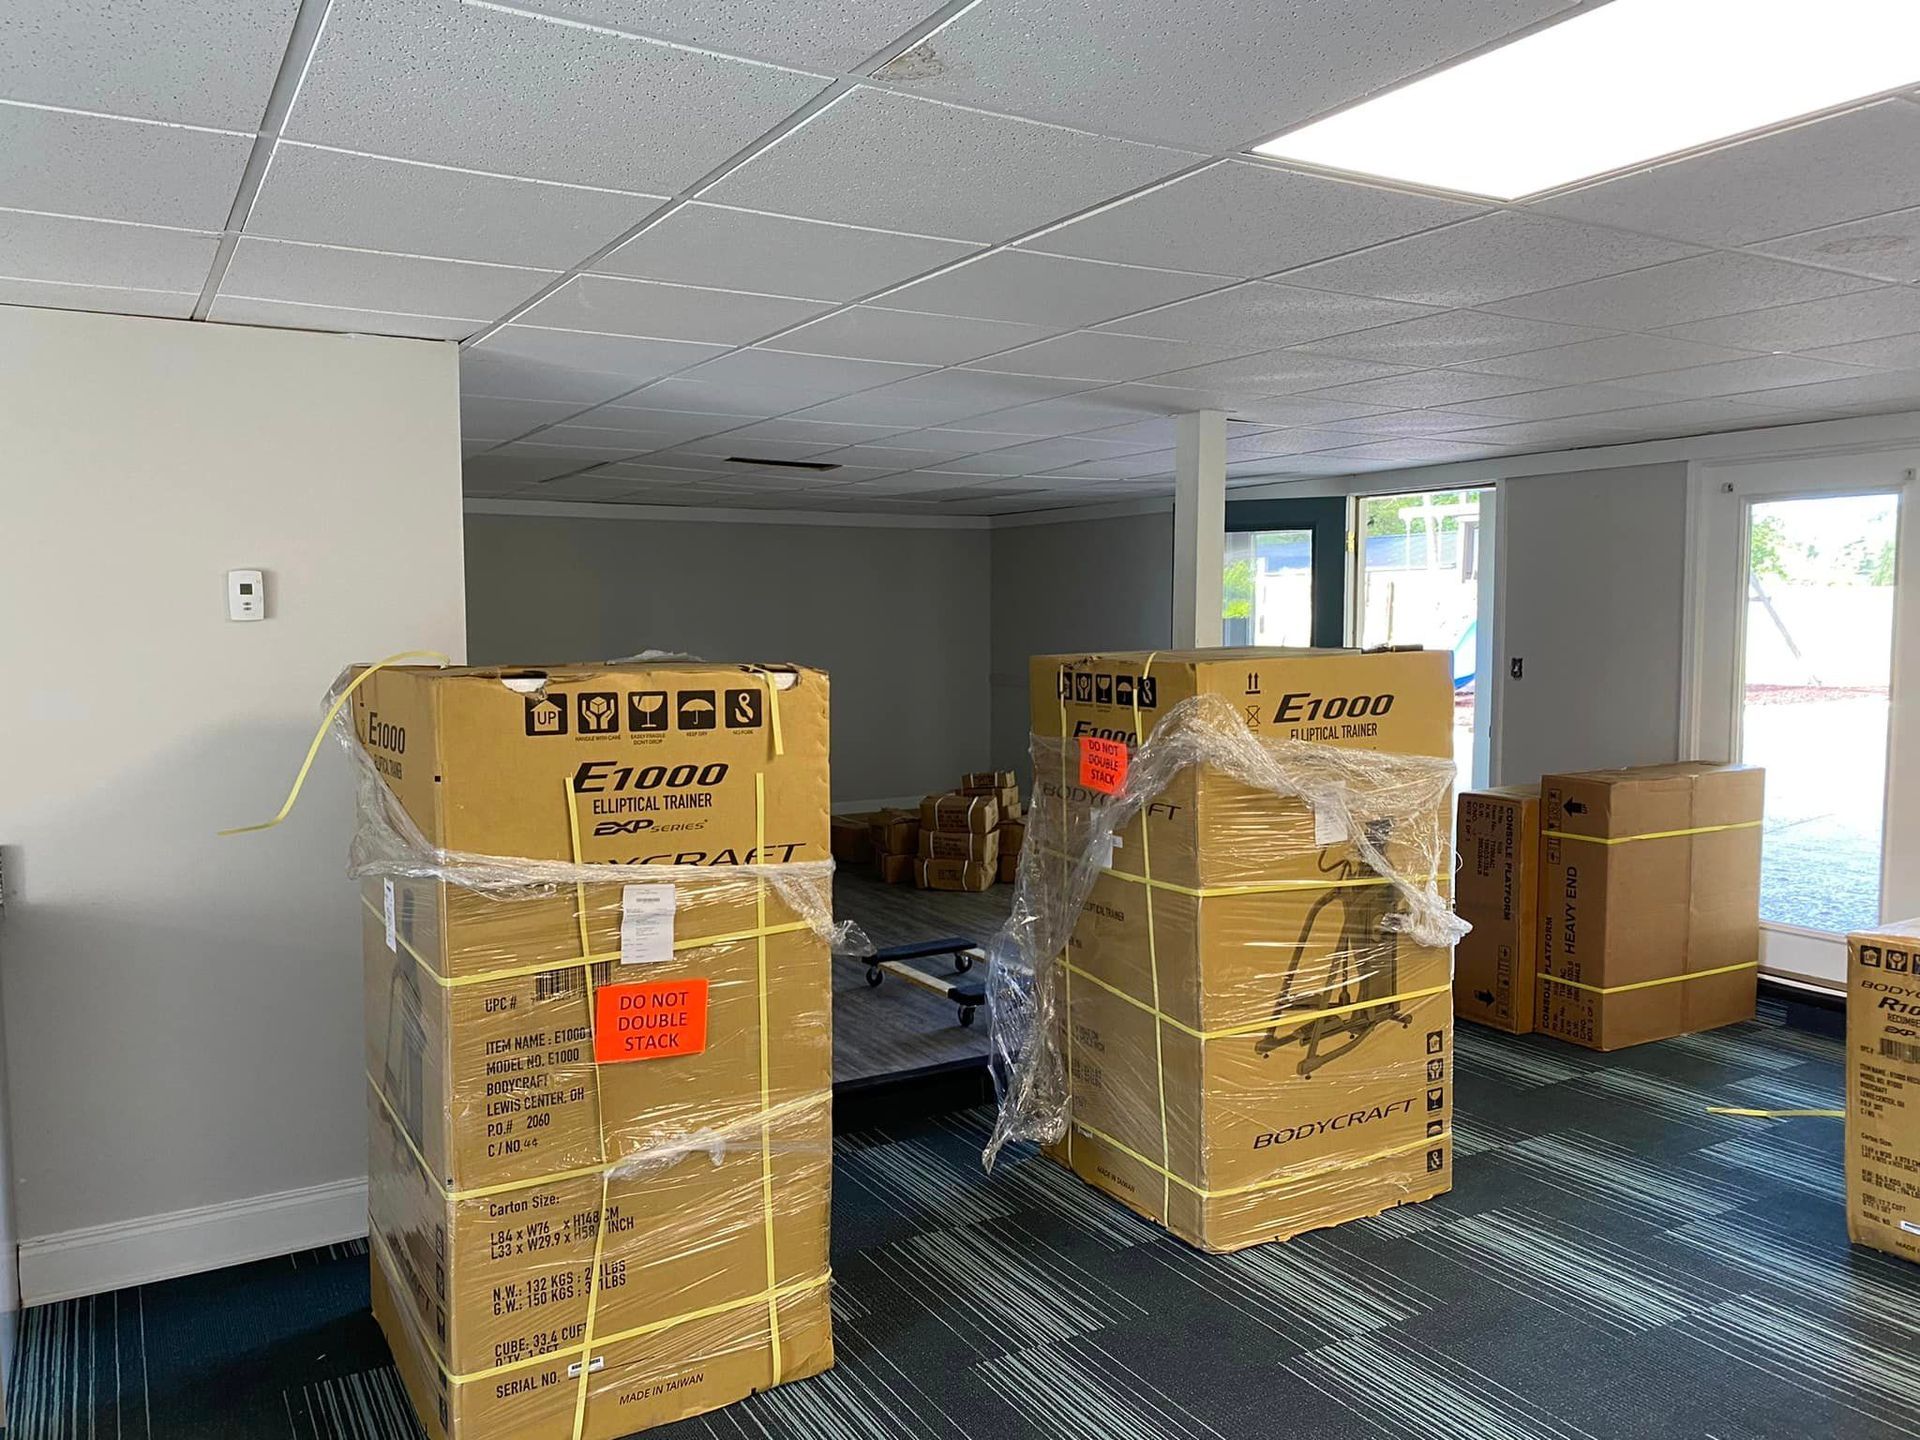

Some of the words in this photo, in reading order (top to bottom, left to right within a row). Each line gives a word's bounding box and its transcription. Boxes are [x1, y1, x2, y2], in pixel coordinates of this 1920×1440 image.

[537, 711, 556, 725] UP
[1273, 692, 1395, 724] E1000
[368, 711, 406, 755] E1000
[1291, 726, 1340, 741] ELLIPTICAL
[1341, 723, 1378, 738] TRAINER
[1088, 739, 1101, 751] DO
[1102, 743, 1119, 756] NOT
[574, 760, 730, 793] E1000
[1088, 753, 1119, 772] DOUBLE
[1090, 769, 1116, 786] STACK
[593, 795, 661, 815] ELLIPTICAL
[663, 793, 712, 811] TRAINER
[593, 819, 654, 837] EXP
[1505, 807, 1514, 859] CONSOLE
[1503, 862, 1513, 921] PLATFORM
[1566, 866, 1578, 900] END
[1564, 904, 1577, 955] HEAVY
[485, 997, 507, 1012] UPC
[510, 994, 517, 1009] #
[620, 994, 646, 1010] DO
[651, 991, 689, 1008] NOT
[618, 1012, 688, 1031] DOUBLE
[486, 1038, 511, 1056] ITEM
[514, 1033, 545, 1050] NAME
[554, 1027, 586, 1045] E1000
[624, 1033, 679, 1051] STACK
[486, 1057, 524, 1076] MODEL
[527, 1054, 545, 1069] NO.
[548, 1048, 580, 1066] E1000
[486, 1073, 549, 1096] BODYCRAFT
[487, 1099, 521, 1117] LEWIS
[570, 1087, 585, 1101] OH
[527, 1113, 551, 1129] 2060
[1253, 1097, 1418, 1149] BODYCRAFT
[490, 1200, 528, 1217] Carton
[532, 1195, 560, 1209] Size:
[491, 1229, 513, 1246] L84
[516, 1230, 524, 1240] x
[526, 1221, 550, 1238] W76
[563, 1219, 571, 1230] x
[573, 1211, 600, 1228] H148
[491, 1243, 513, 1260] L33
[516, 1244, 524, 1254] x
[527, 1233, 561, 1251] W29.9
[564, 1233, 571, 1243] x
[608, 1216, 634, 1234] INCH
[493, 1284, 522, 1302] N.W.:
[527, 1277, 547, 1294] 132
[551, 1272, 574, 1288] KGS
[584, 1260, 626, 1280] 21LBS
[493, 1298, 523, 1316] G.W.:
[527, 1292, 547, 1309] 150
[551, 1285, 574, 1302] KGS
[585, 1274, 626, 1294] 31LBS
[495, 1338, 530, 1358] CUBE:
[532, 1327, 558, 1348] 33.4
[496, 1377, 538, 1399] SERIAL
[541, 1371, 561, 1387] NO.
[619, 1387, 650, 1405] MADE
[652, 1384, 664, 1396] IN
[666, 1373, 704, 1393] TAIWAN
